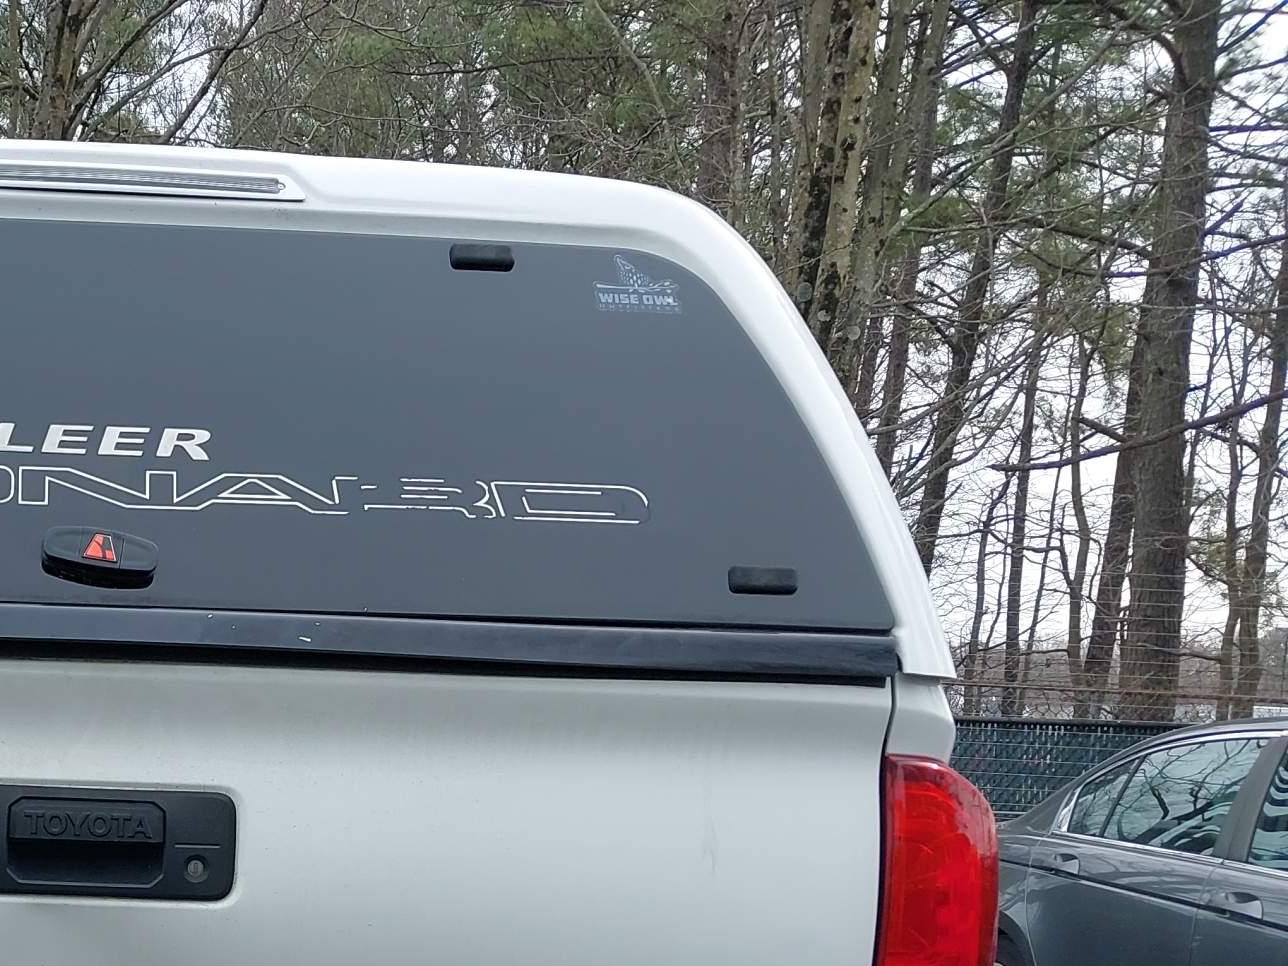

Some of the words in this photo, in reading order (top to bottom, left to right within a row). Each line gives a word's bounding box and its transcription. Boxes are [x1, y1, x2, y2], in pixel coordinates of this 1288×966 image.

[598, 292, 640, 305] WISE
[642, 294, 679, 306] OWL
[23, 809, 153, 840] TOYOTA
